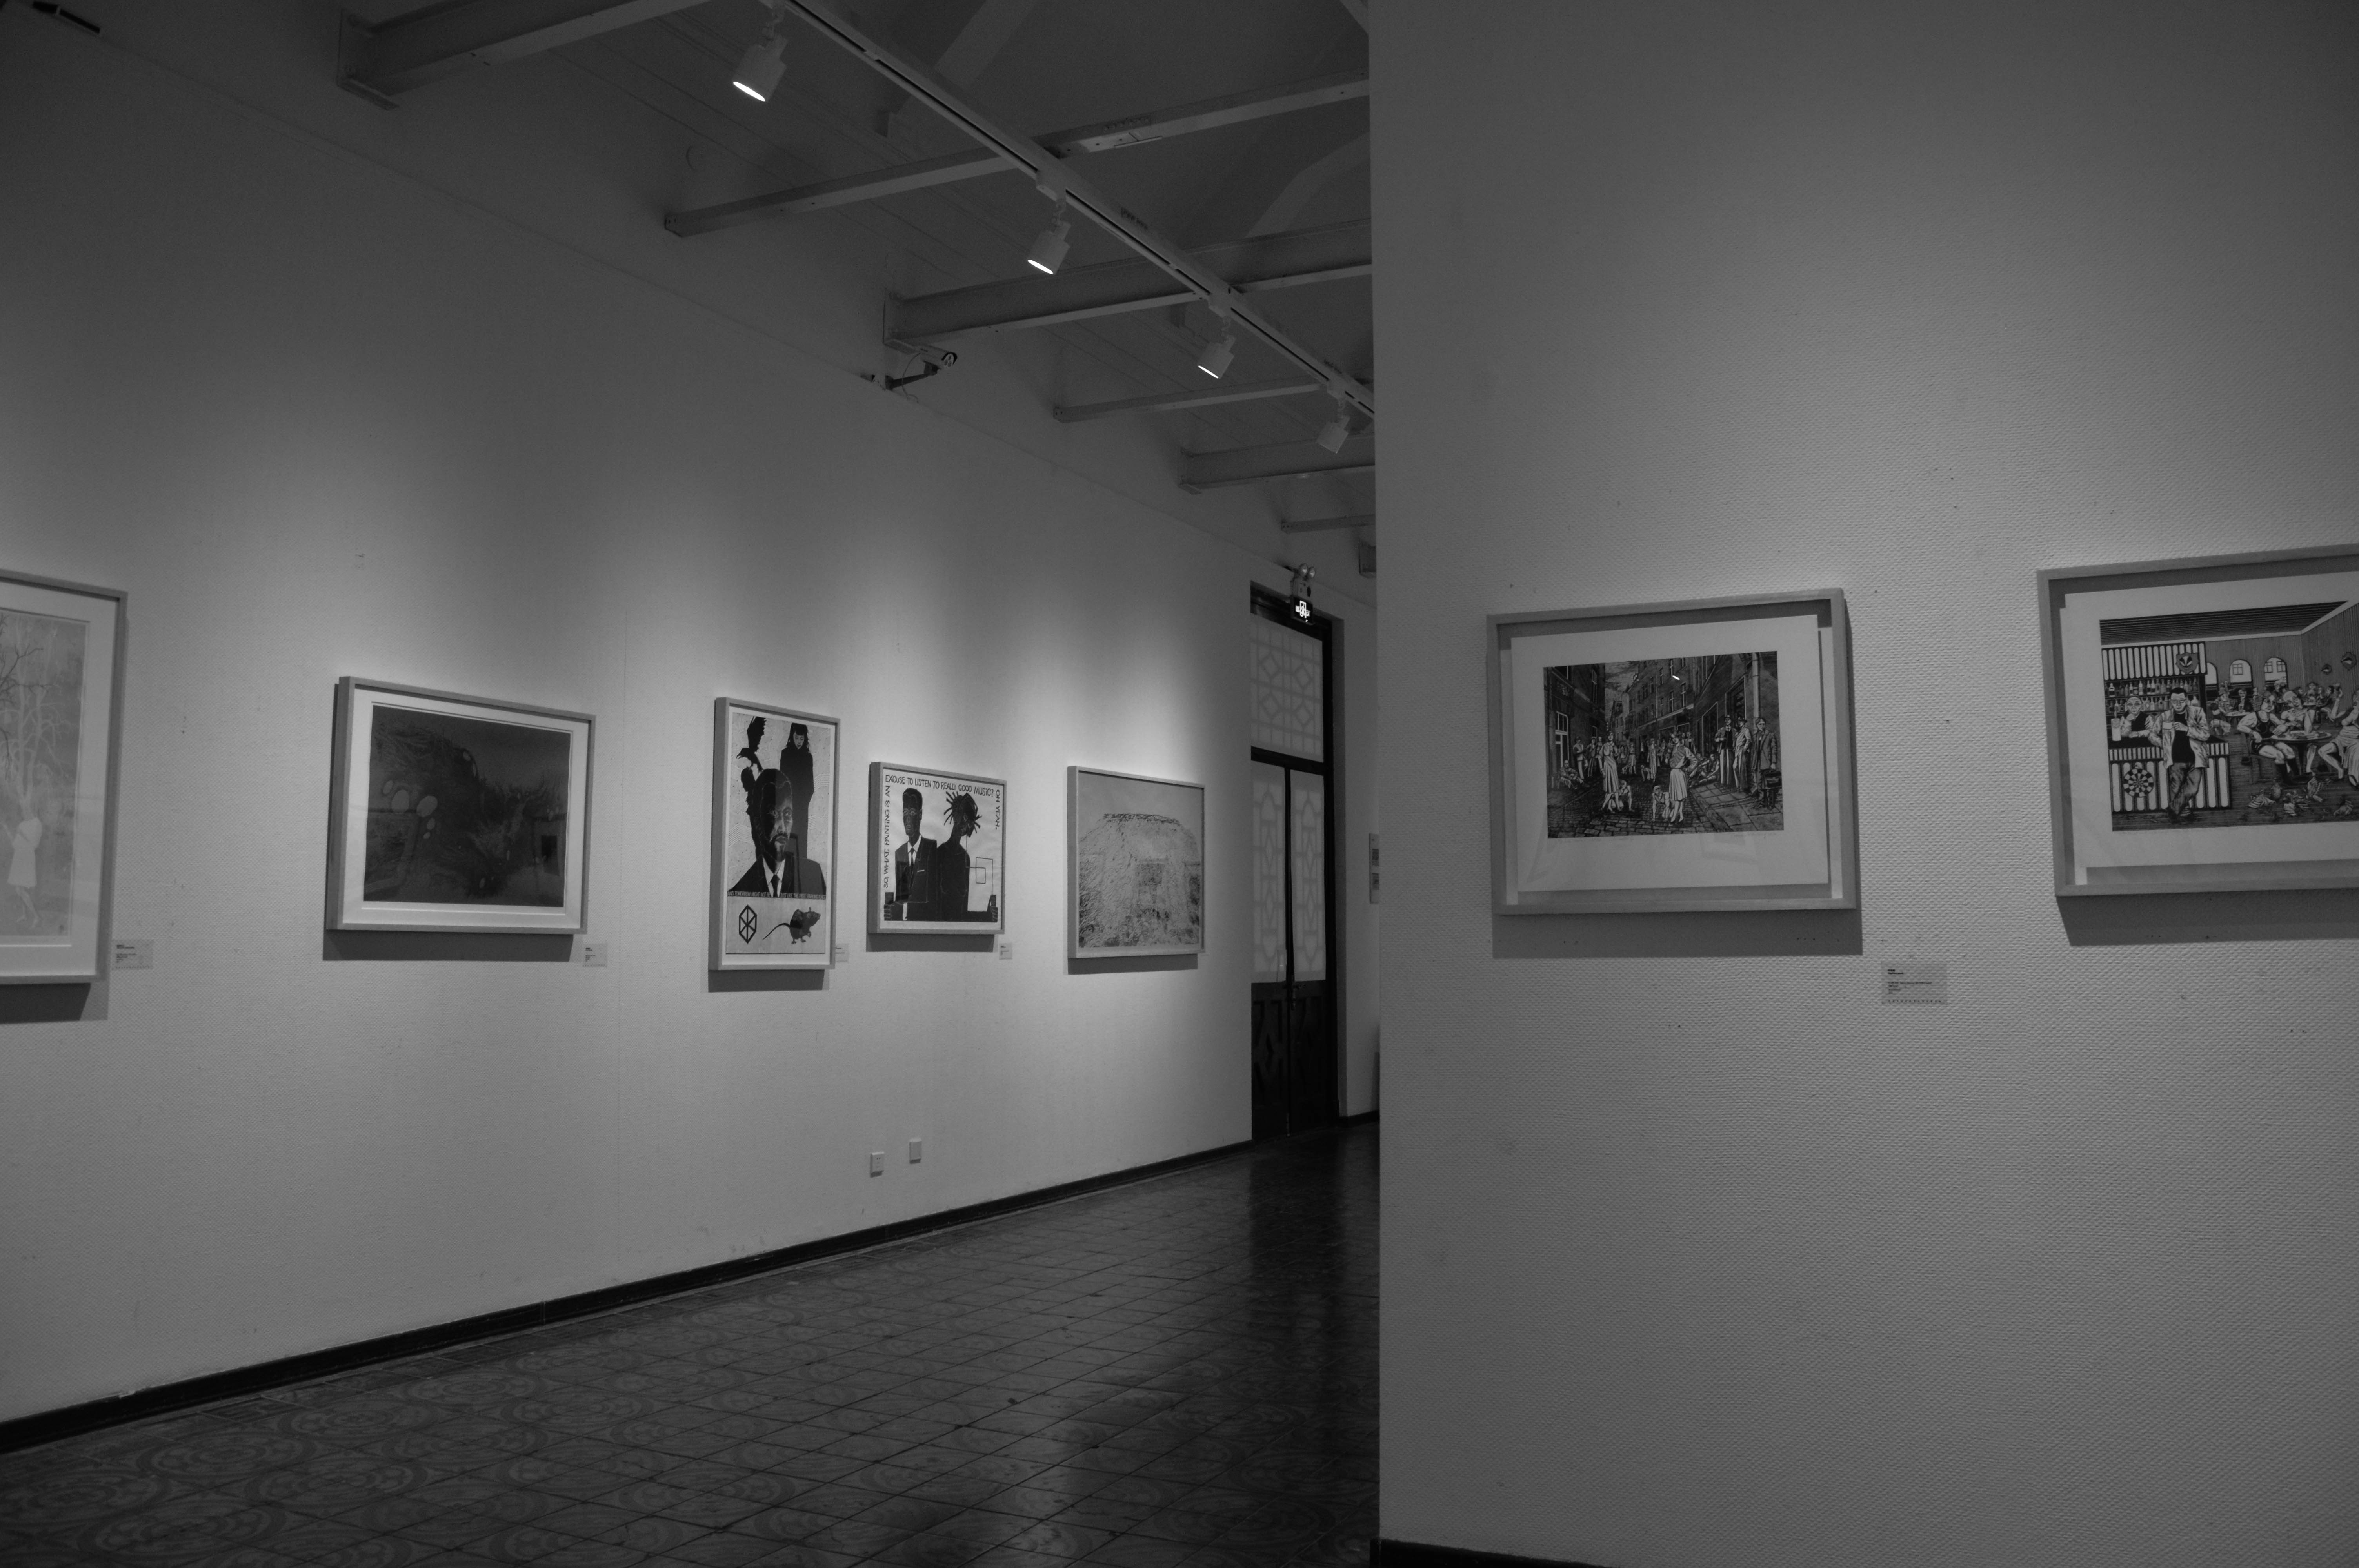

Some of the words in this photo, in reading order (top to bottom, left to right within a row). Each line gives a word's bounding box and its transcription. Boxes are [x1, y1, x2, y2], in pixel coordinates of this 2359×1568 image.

[885, 786, 890, 797] AN
[933, 781, 940, 789] TO
[941, 782, 957, 791] REALLY
[996, 789, 1000, 802] OH
